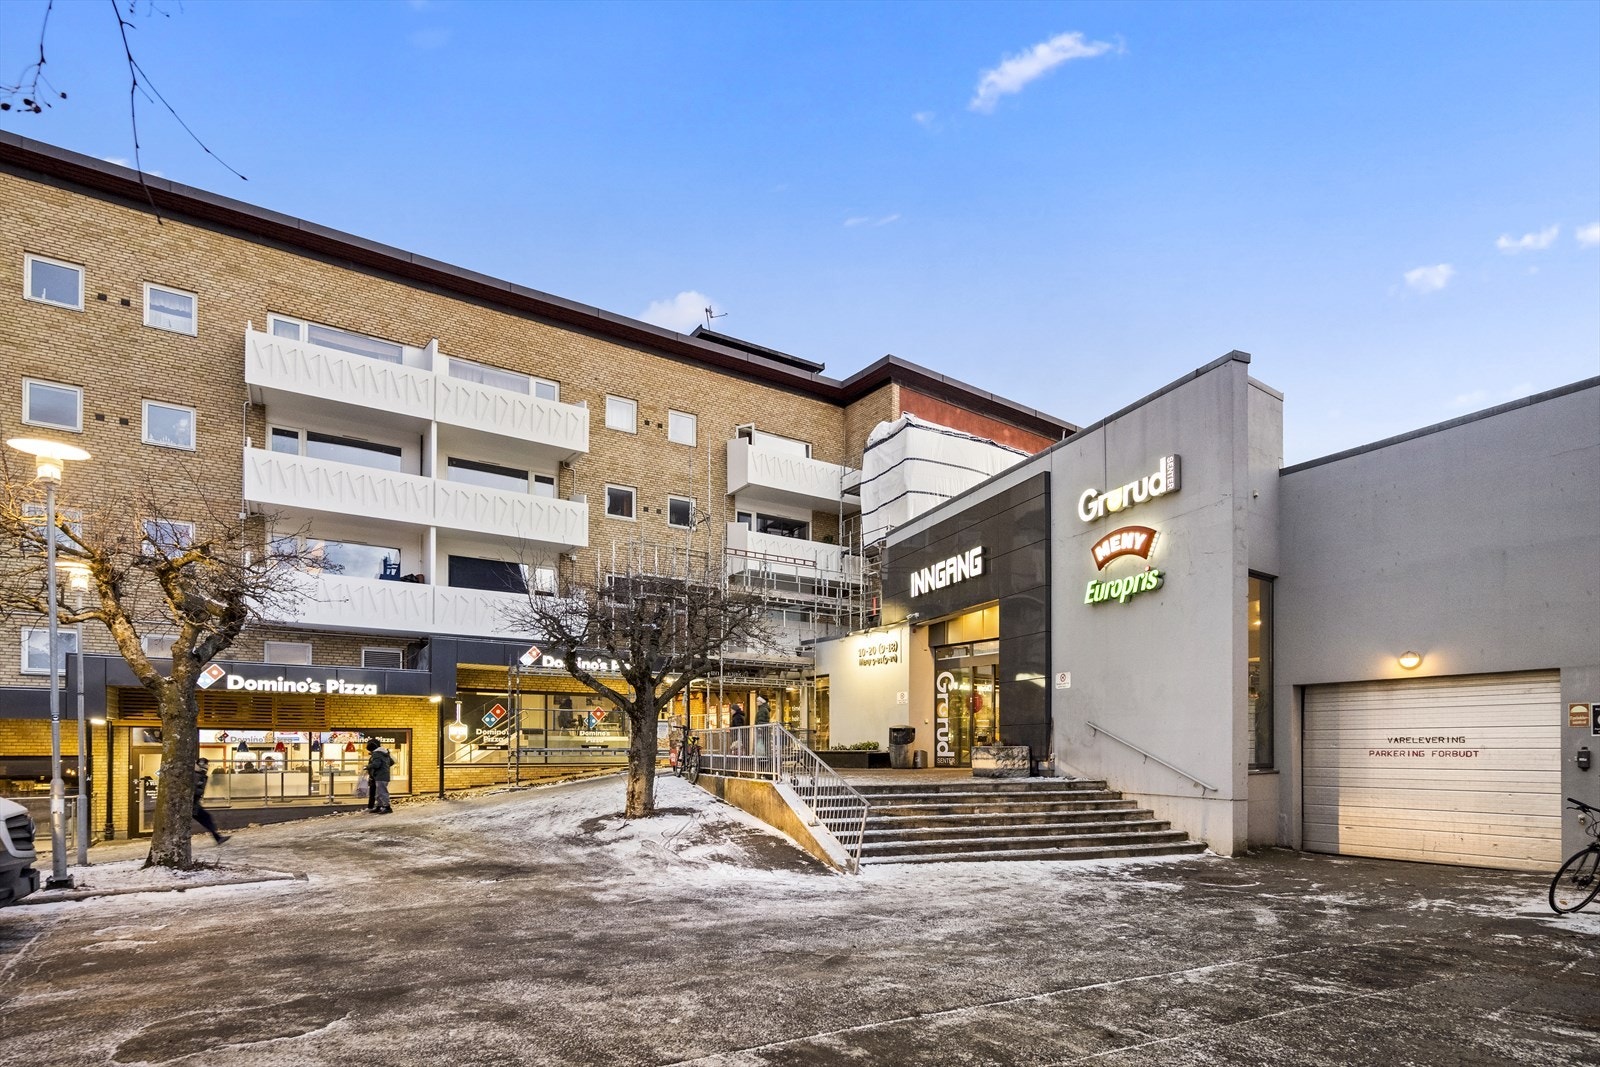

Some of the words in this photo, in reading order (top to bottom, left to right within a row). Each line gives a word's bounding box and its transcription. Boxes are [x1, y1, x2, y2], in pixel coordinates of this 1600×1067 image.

[1094, 532, 1148, 562] MENY
[910, 545, 983, 598] INNGANG
[1084, 566, 1159, 604] Europris
[227, 674, 322, 693] Domino's
[326, 678, 378, 695] Pizza
[1388, 736, 1466, 744] VARELEVERING
[1432, 750, 1479, 758] FORBUDT
